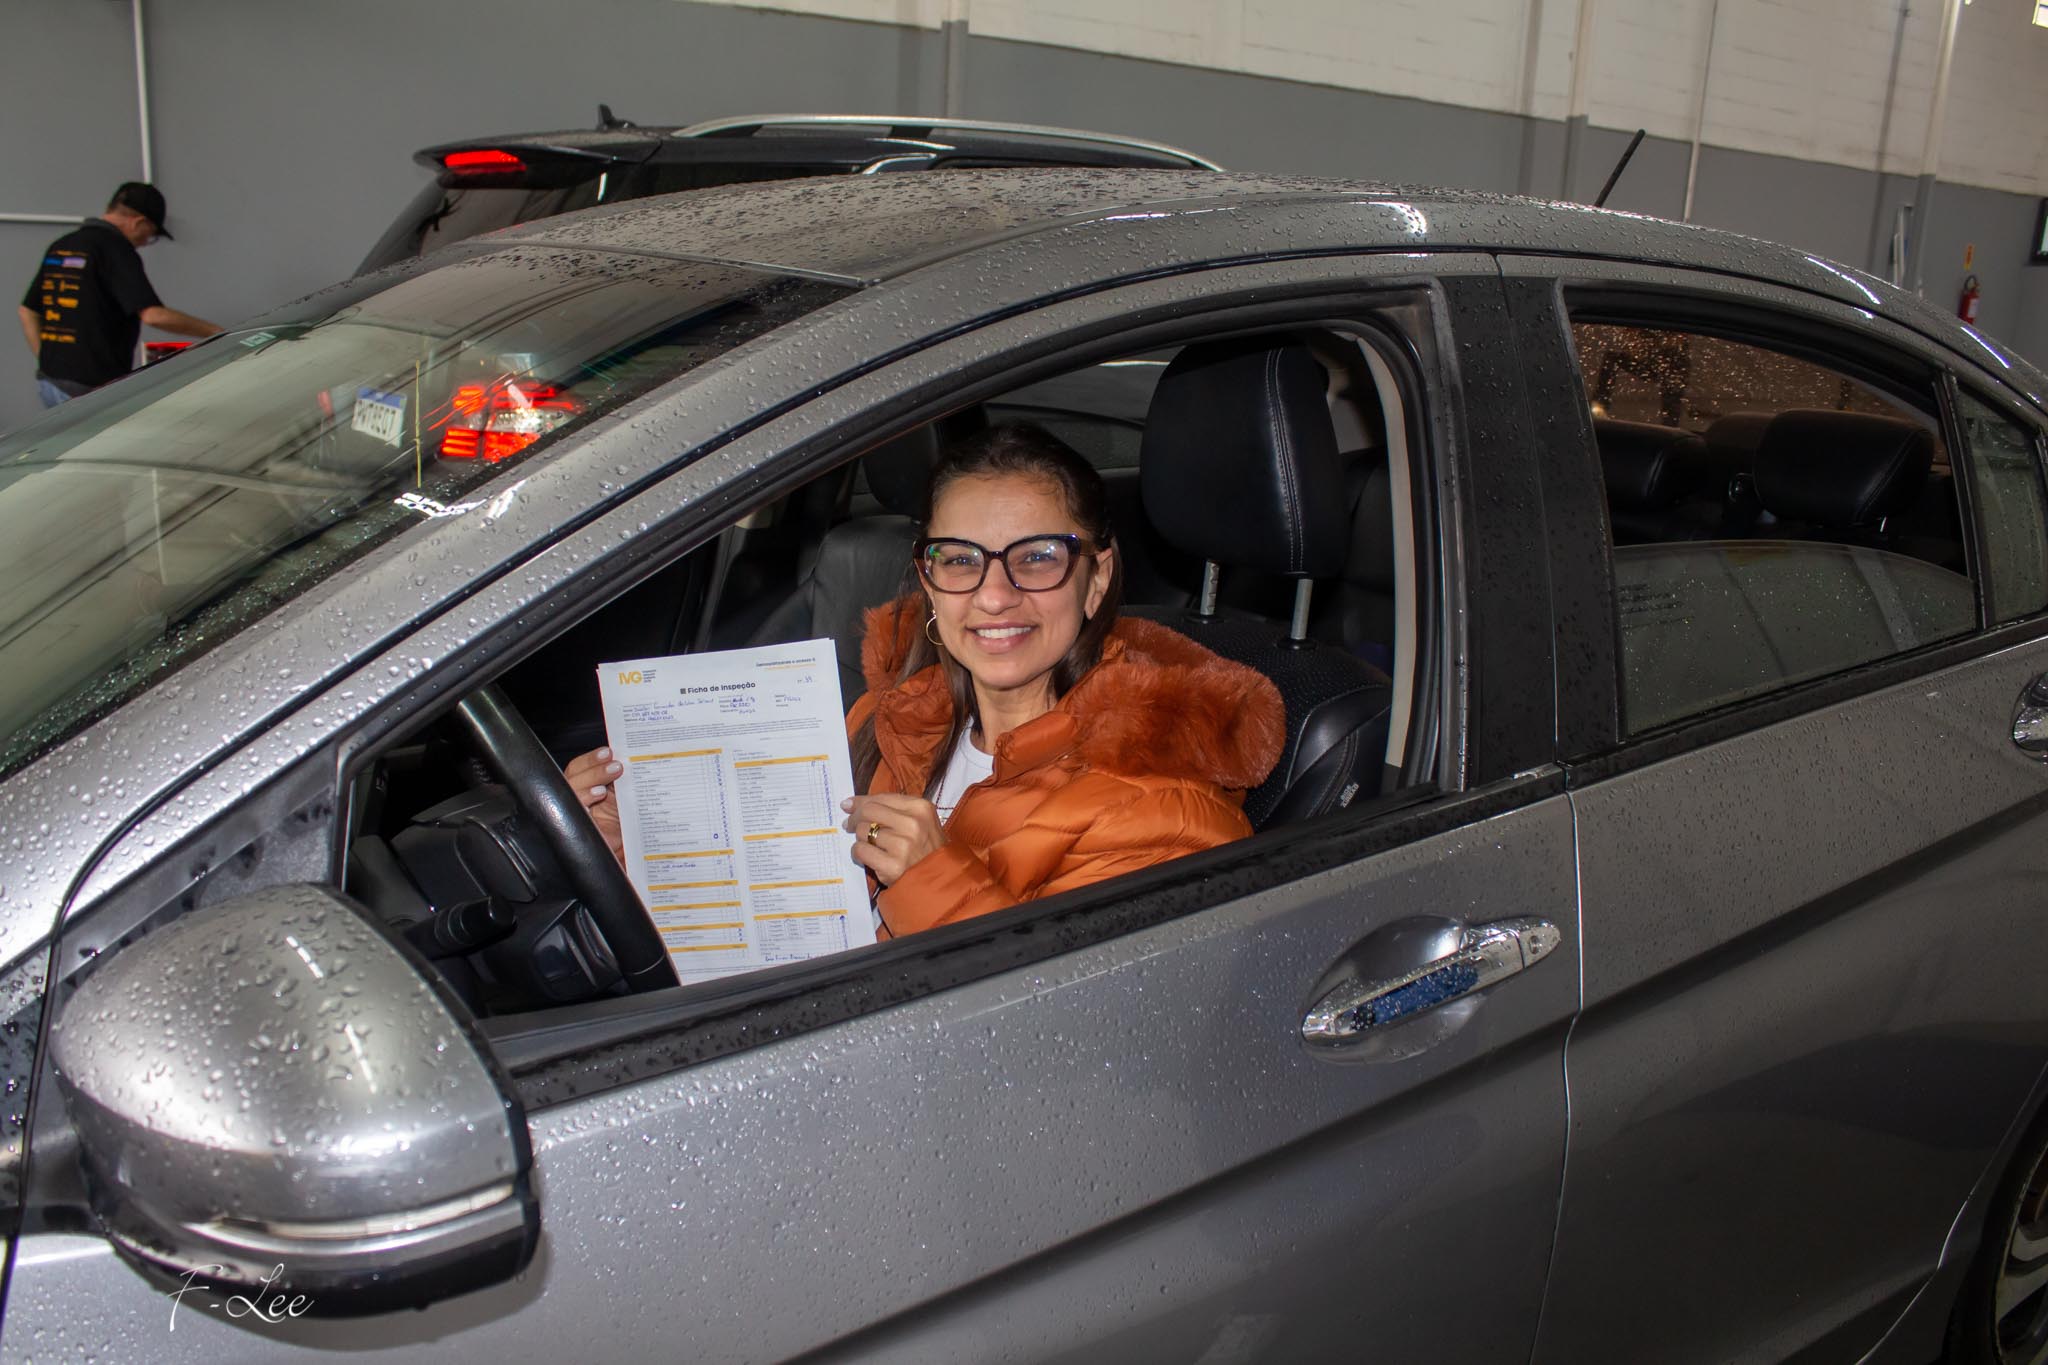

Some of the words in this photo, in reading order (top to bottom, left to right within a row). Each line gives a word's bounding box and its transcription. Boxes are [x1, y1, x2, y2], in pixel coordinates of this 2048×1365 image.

[618, 671, 643, 686] IVG
[688, 685, 708, 694] Ficha
[710, 684, 720, 692] de
[721, 681, 756, 691] Inspeção
